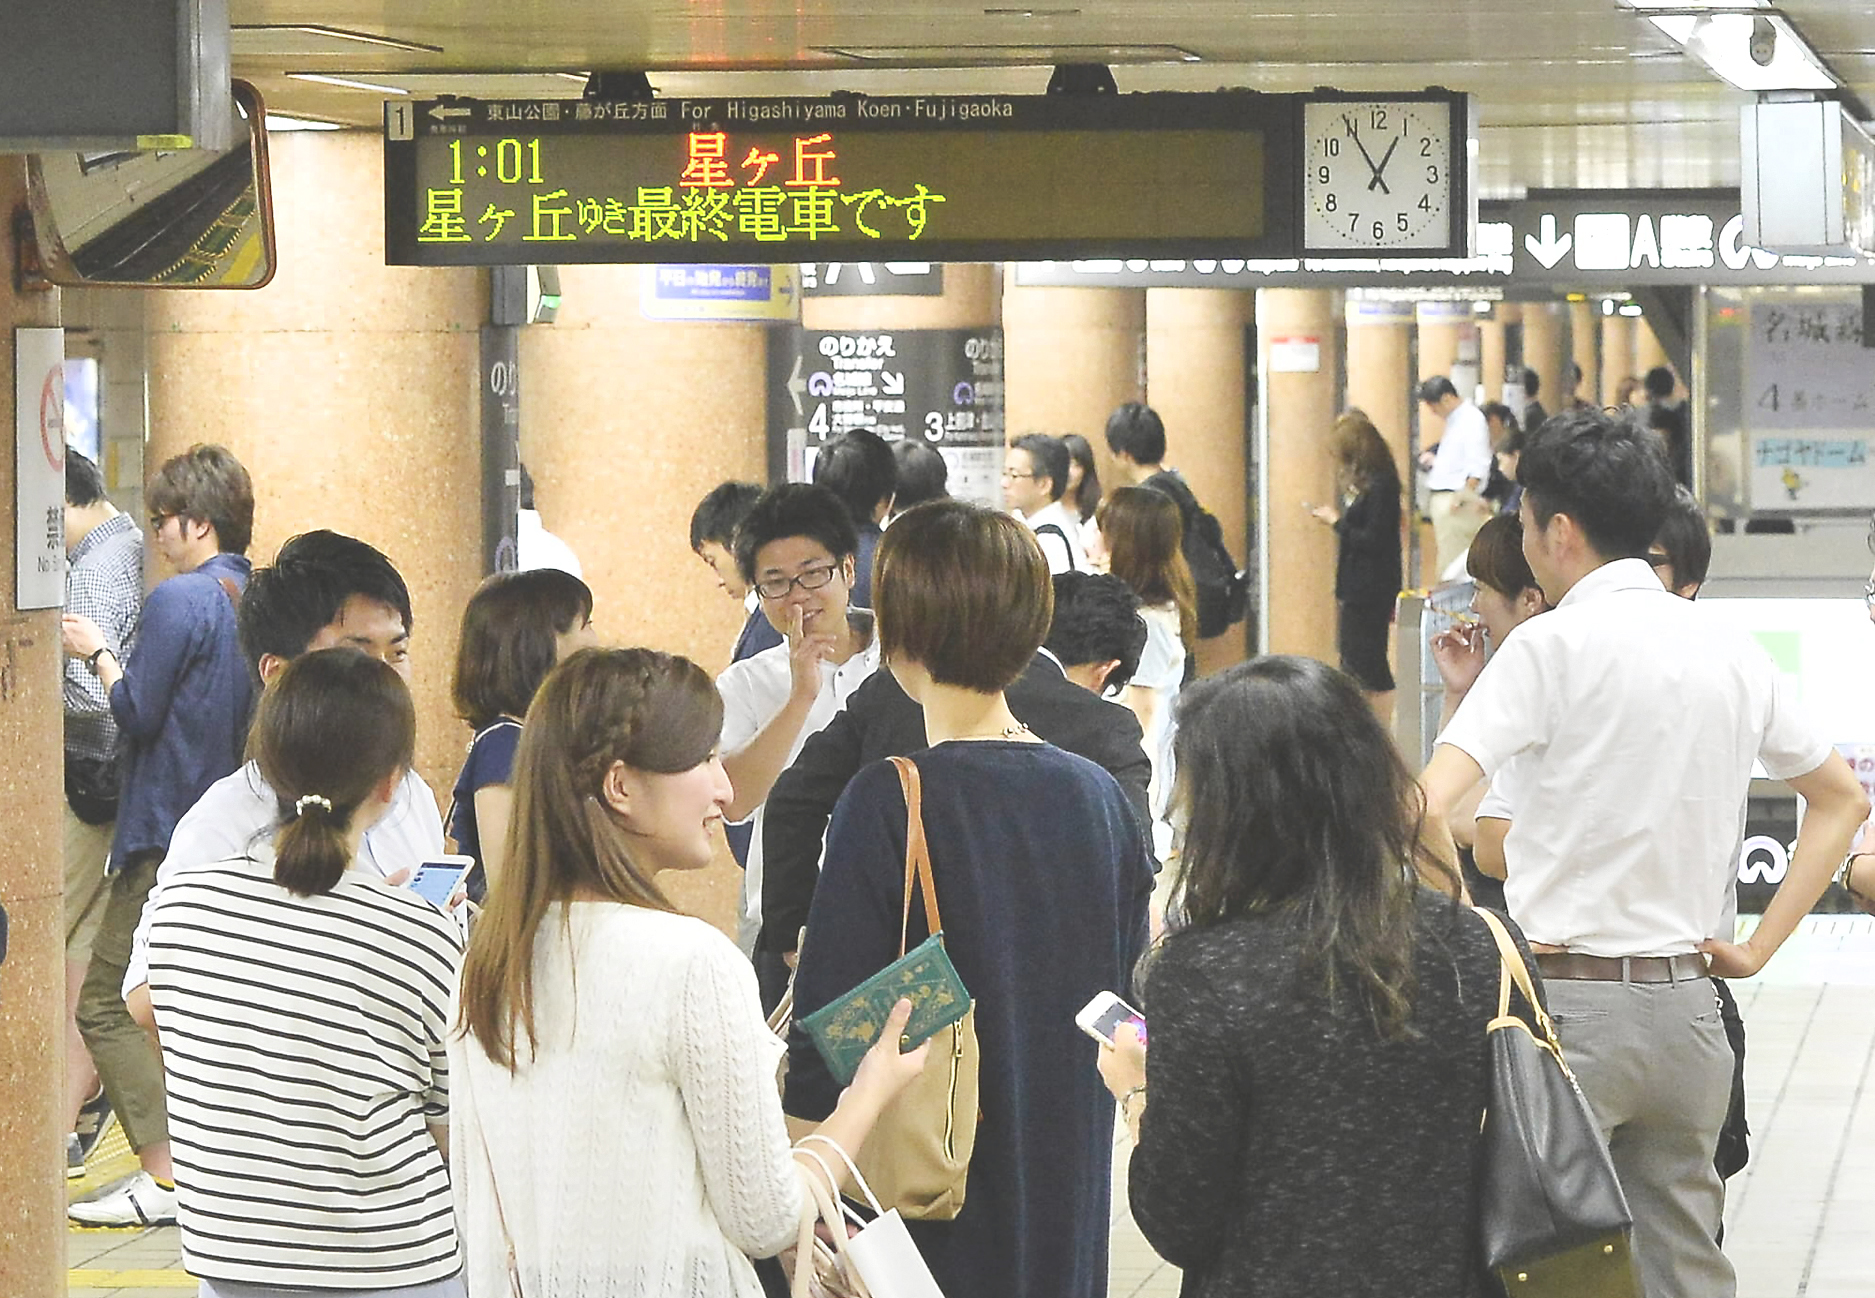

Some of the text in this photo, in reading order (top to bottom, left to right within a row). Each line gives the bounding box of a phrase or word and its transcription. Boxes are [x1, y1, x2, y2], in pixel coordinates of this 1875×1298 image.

[681, 103, 711, 119] For
[727, 102, 846, 121] Higashiyama
[1370, 110, 1388, 130] 12
[395, 107, 405, 136] 1
[1403, 118, 1407, 137] 1
[1324, 138, 1339, 157] 10
[1420, 137, 1431, 157] 2
[449, 138, 544, 184] 1:01
[1318, 166, 1330, 184] 9
[1426, 165, 1439, 184] 3
[1326, 193, 1337, 212] 8
[1418, 193, 1431, 212] 4
[1348, 213, 1360, 232] 7
[1372, 221, 1384, 239] 6
[1397, 213, 1408, 232] 5
[818, 334, 897, 357] のりかえ
[808, 402, 831, 441] 4
[924, 411, 945, 442] 3
